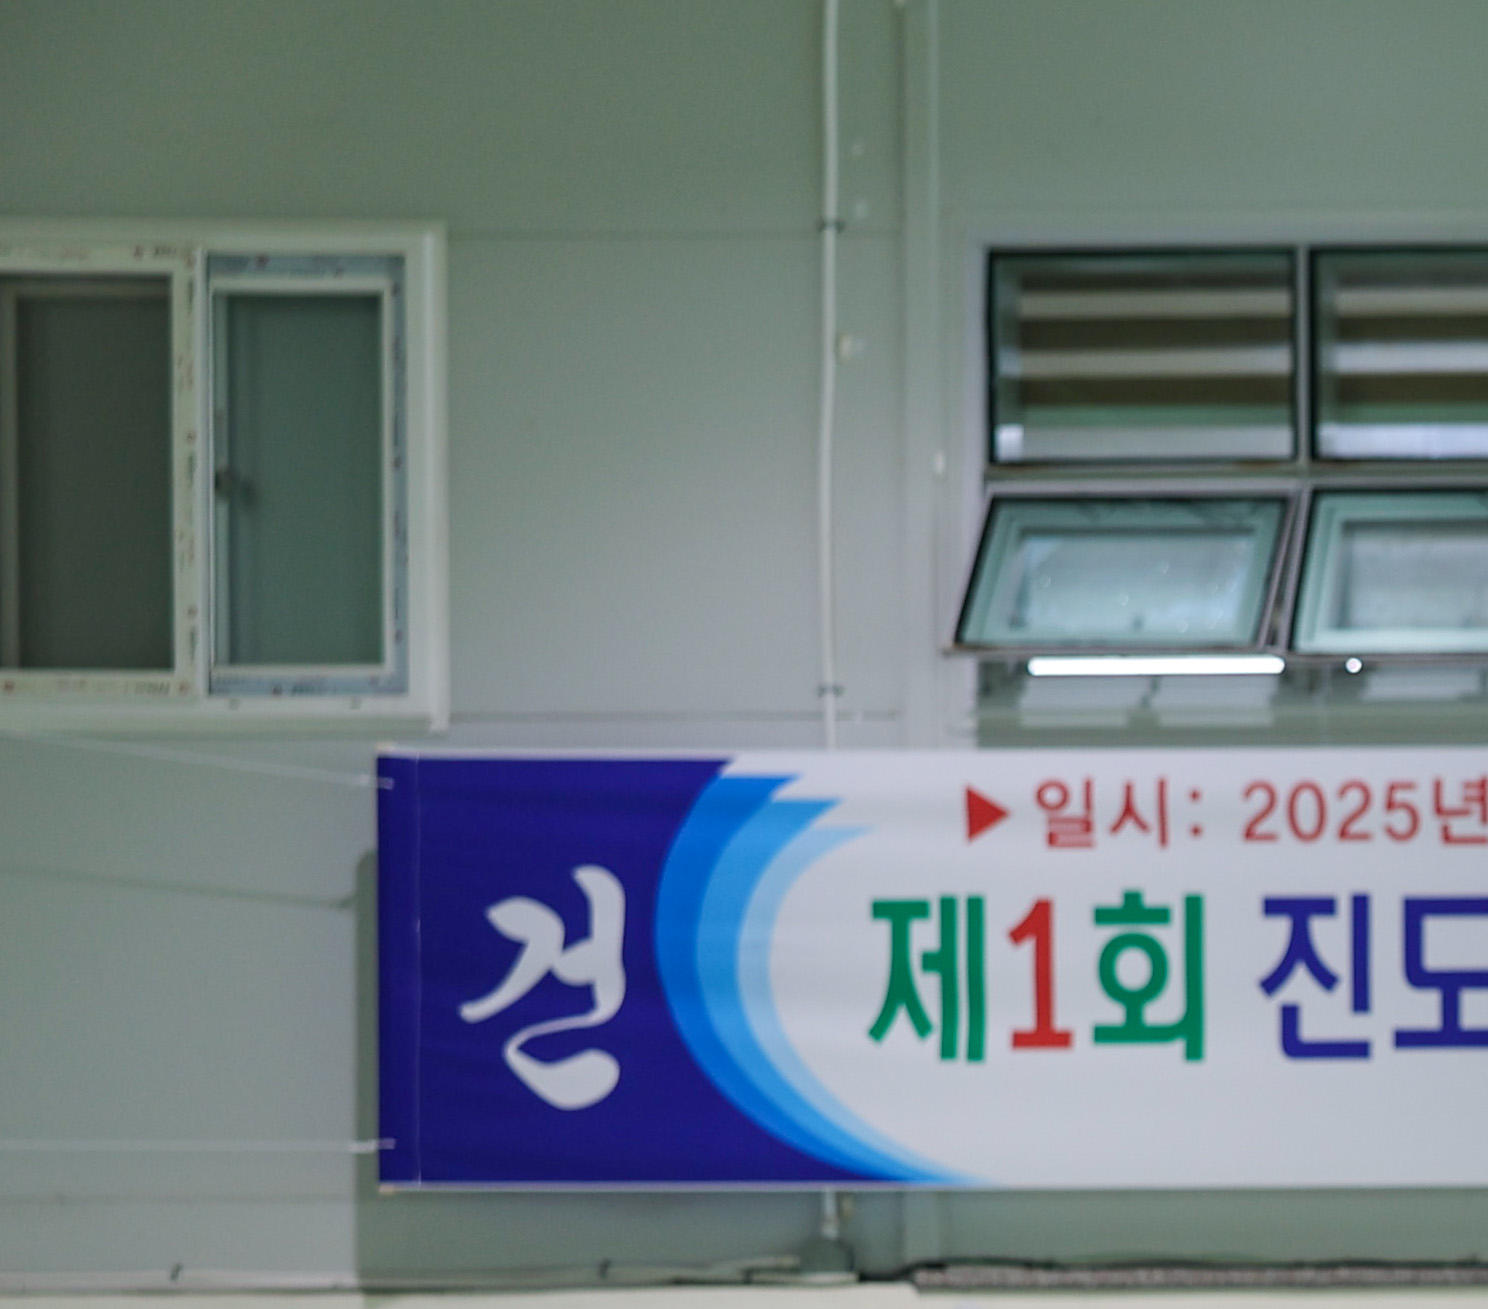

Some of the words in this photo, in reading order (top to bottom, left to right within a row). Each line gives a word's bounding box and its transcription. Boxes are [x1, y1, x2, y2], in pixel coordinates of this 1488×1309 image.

[1034, 776, 1204, 850] 일시:
[459, 864, 628, 1111] 건
[866, 888, 1207, 1065] 제1회
